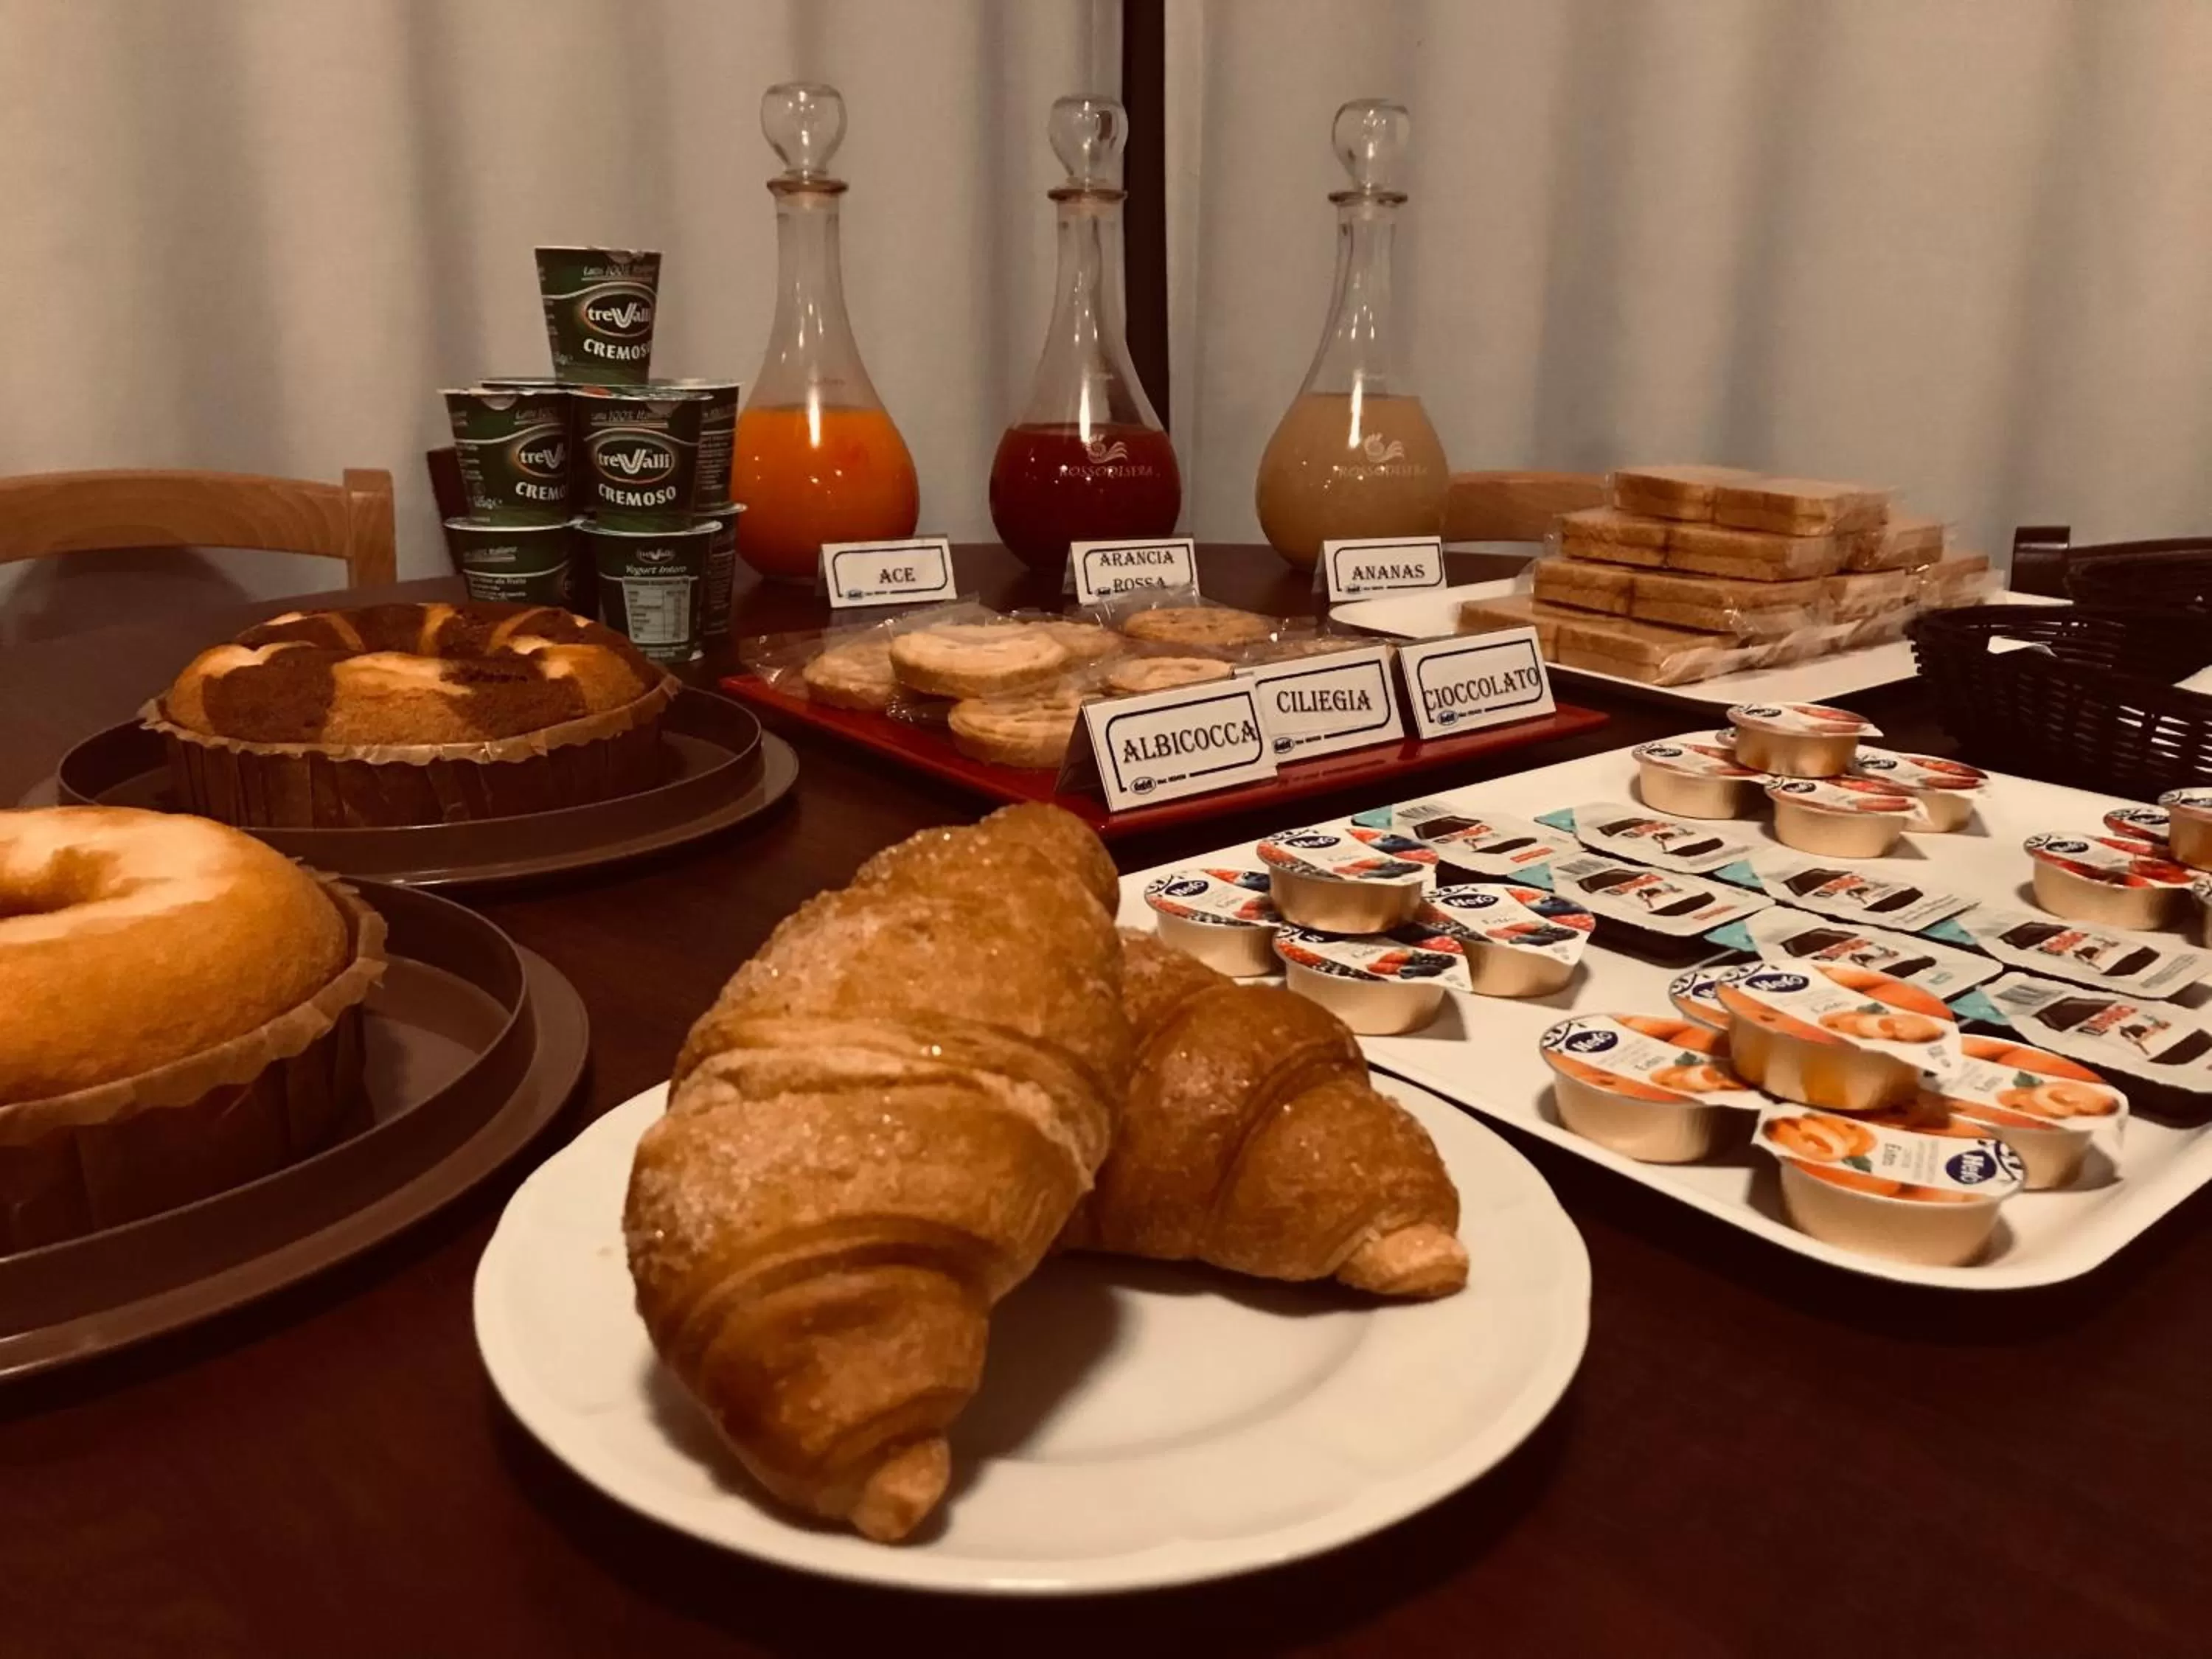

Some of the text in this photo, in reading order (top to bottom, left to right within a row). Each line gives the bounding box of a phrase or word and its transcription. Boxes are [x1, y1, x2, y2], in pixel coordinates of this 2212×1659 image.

[583, 338, 651, 360] CREMOS
[598, 448, 671, 474] treValli
[598, 484, 677, 507] CREMOSO
[1099, 551, 1175, 566] ARANCIA
[879, 567, 916, 584] ACE
[1352, 564, 1425, 580] ANANAS
[1423, 667, 1540, 712] CIOCCOLATO
[1276, 689, 1372, 713] CILIEGIA
[1123, 720, 1259, 764] ALBICOCCA
[1450, 895, 1495, 907] Hero
